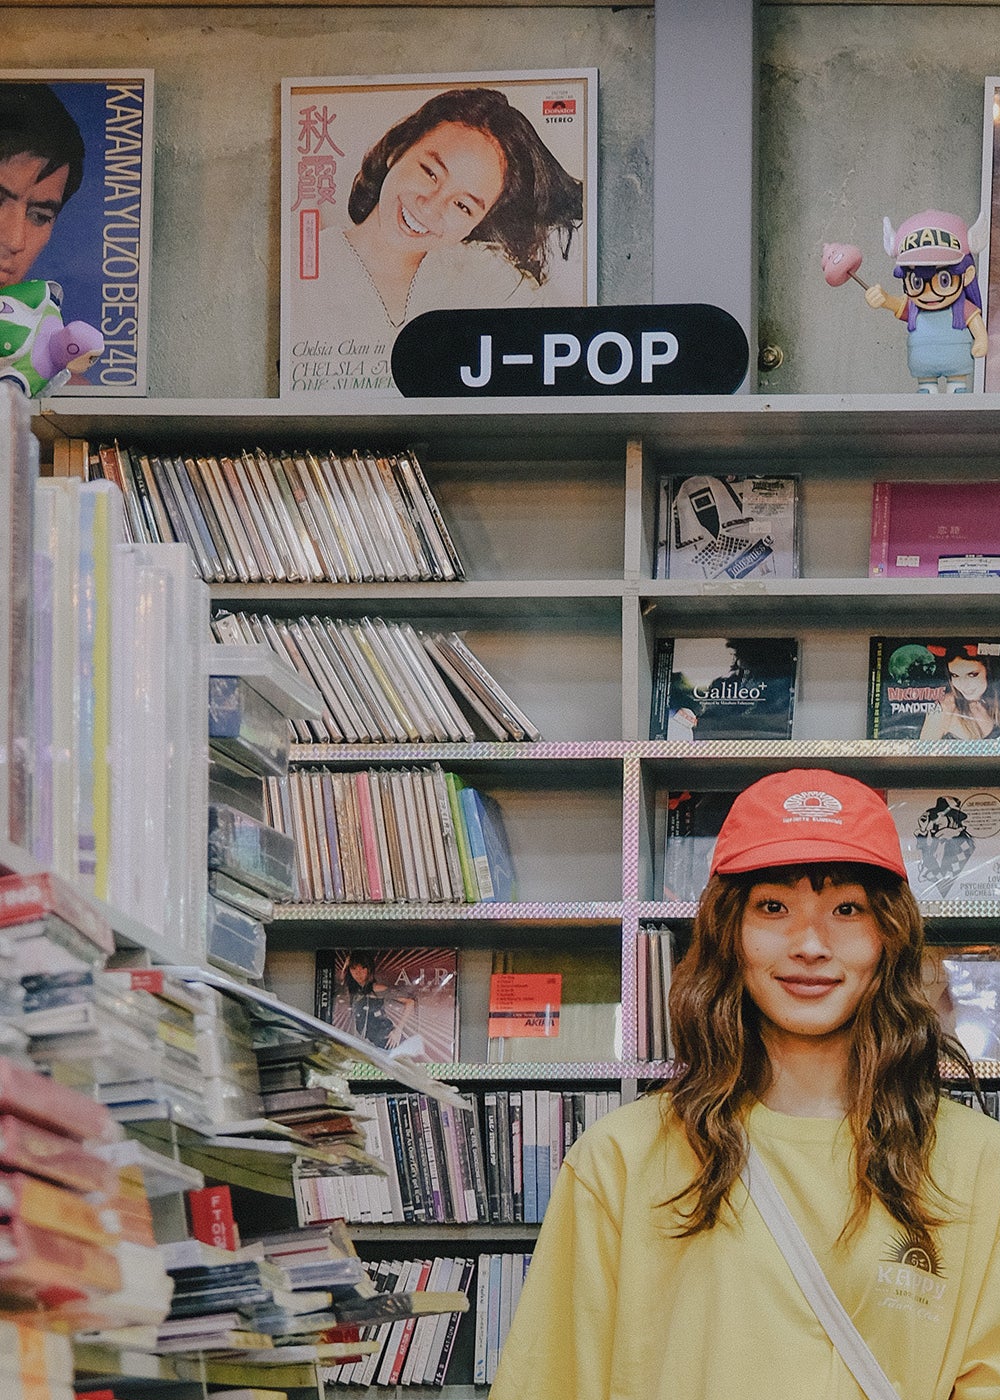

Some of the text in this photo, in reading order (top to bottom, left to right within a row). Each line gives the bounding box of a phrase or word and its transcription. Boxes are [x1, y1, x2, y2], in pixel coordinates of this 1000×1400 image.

[545, 116, 574, 124] STEREO
[105, 83, 143, 201] KAYAMA
[291, 105, 345, 211] 秋霞
[102, 202, 141, 277] YUZO
[101, 280, 139, 348] BEST
[292, 339, 386, 357] Chelsia Chan in
[459, 331, 679, 388] J-POP
[887, 686, 947, 701] NICOTINE
[890, 702, 942, 715] PANDORA
[525, 1018, 555, 1027] AKIA
